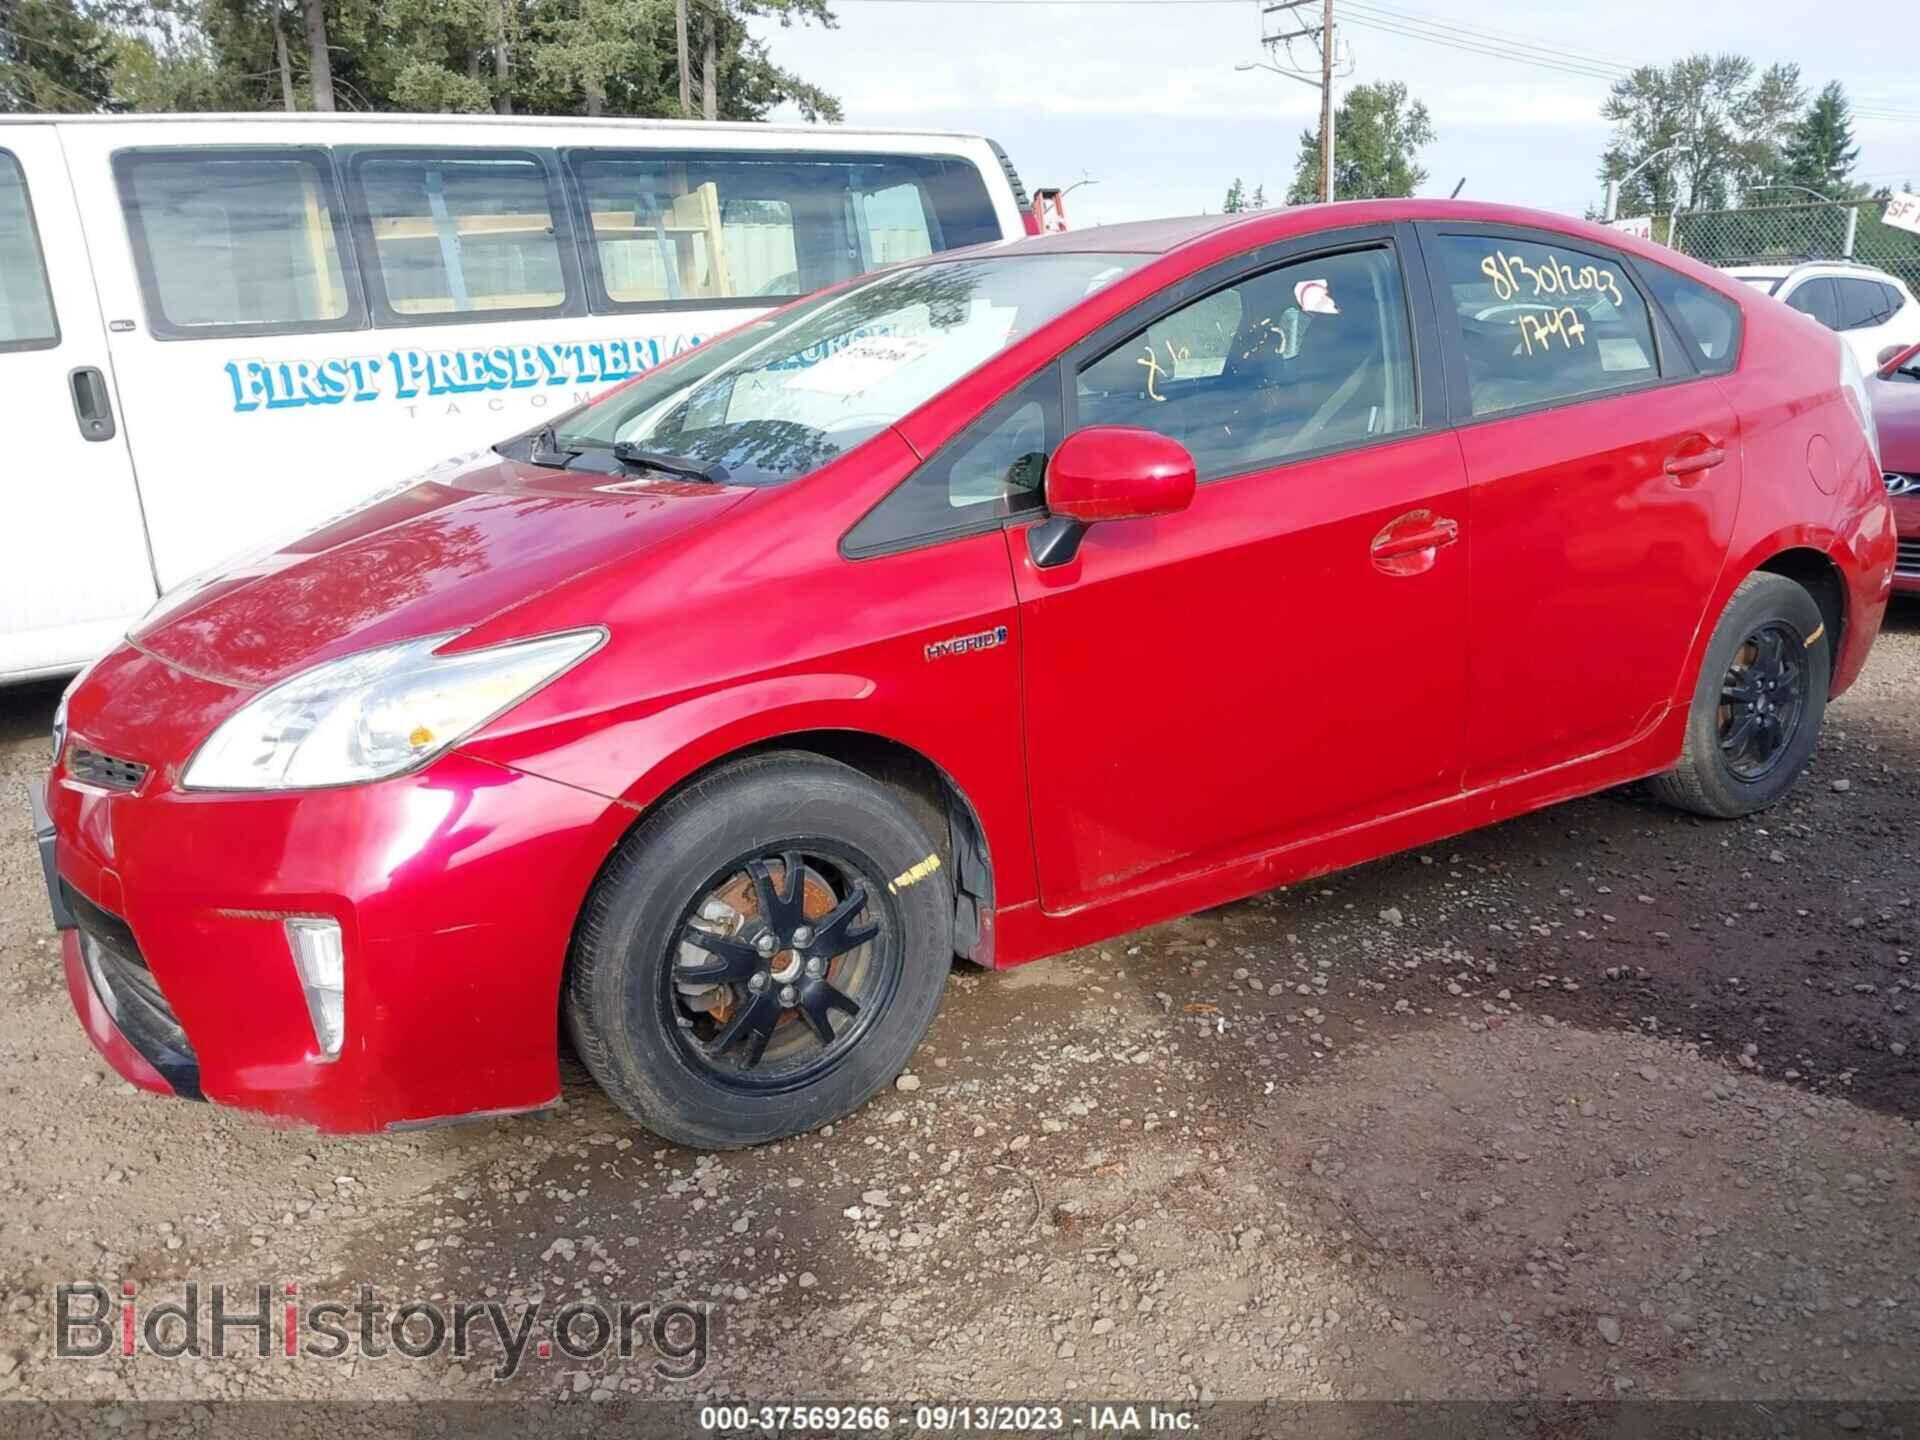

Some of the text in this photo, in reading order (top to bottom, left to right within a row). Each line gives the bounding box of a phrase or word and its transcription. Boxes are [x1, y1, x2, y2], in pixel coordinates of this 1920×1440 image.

[1519, 306, 1585, 356] 1747
[224, 355, 382, 412] FIRST
[388, 332, 710, 400] PRESBYTERIA
[925, 631, 996, 660] HYBRID
